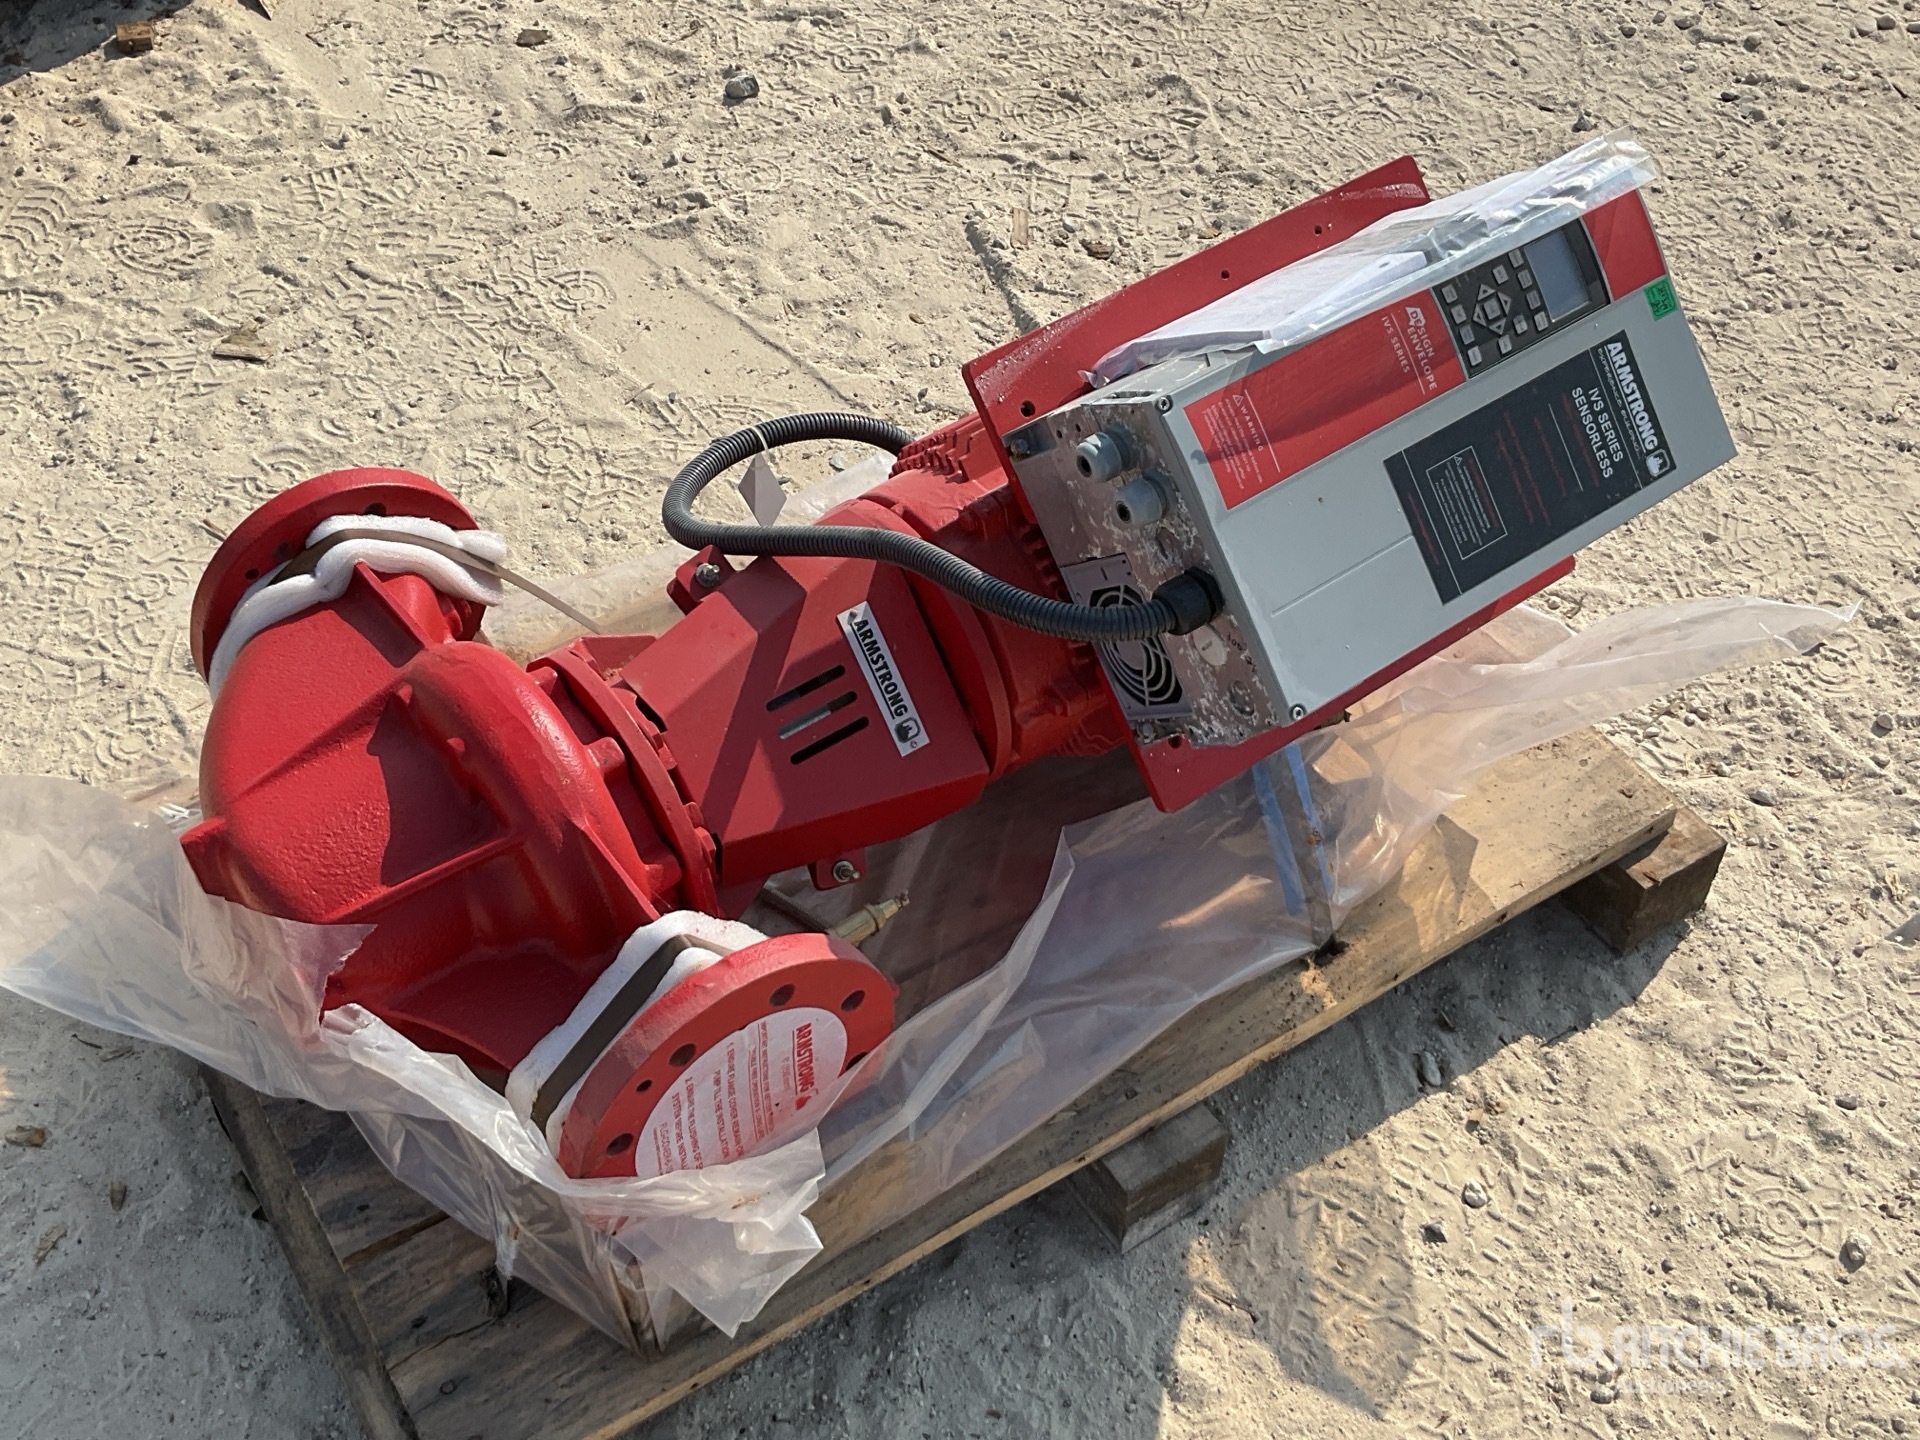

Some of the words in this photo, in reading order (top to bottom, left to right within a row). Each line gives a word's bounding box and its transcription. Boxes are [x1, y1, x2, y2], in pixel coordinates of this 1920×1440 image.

[1381, 316, 1394, 334] IVS
[1390, 336, 1410, 373] SERIES
[1411, 310, 1435, 357] DESIGN
[1408, 328, 1437, 390] ENVELOPE
[1608, 342, 1659, 451] ARMSTRONG
[1241, 406, 1264, 452] WARNING
[1572, 387, 1613, 478] SENSORLESS
[1588, 388, 1605, 411] IVS
[1598, 412, 1623, 461] SERIES
[854, 619, 908, 717] ARMSTRONG
[796, 1022, 814, 1093] ARMSTRONG
[672, 1092, 681, 1119] SYSTEM
[727, 1073, 735, 1098] FLANGE
[675, 1117, 683, 1144] BEFORE
[729, 1097, 737, 1122] COVER
[678, 1142, 688, 1170] INSTALL
[688, 1119, 699, 1153] FLUSHING
[694, 1152, 701, 1164] OF
[716, 1113, 729, 1159] INSTALLATION
[732, 1120, 741, 1146] REMAIN
